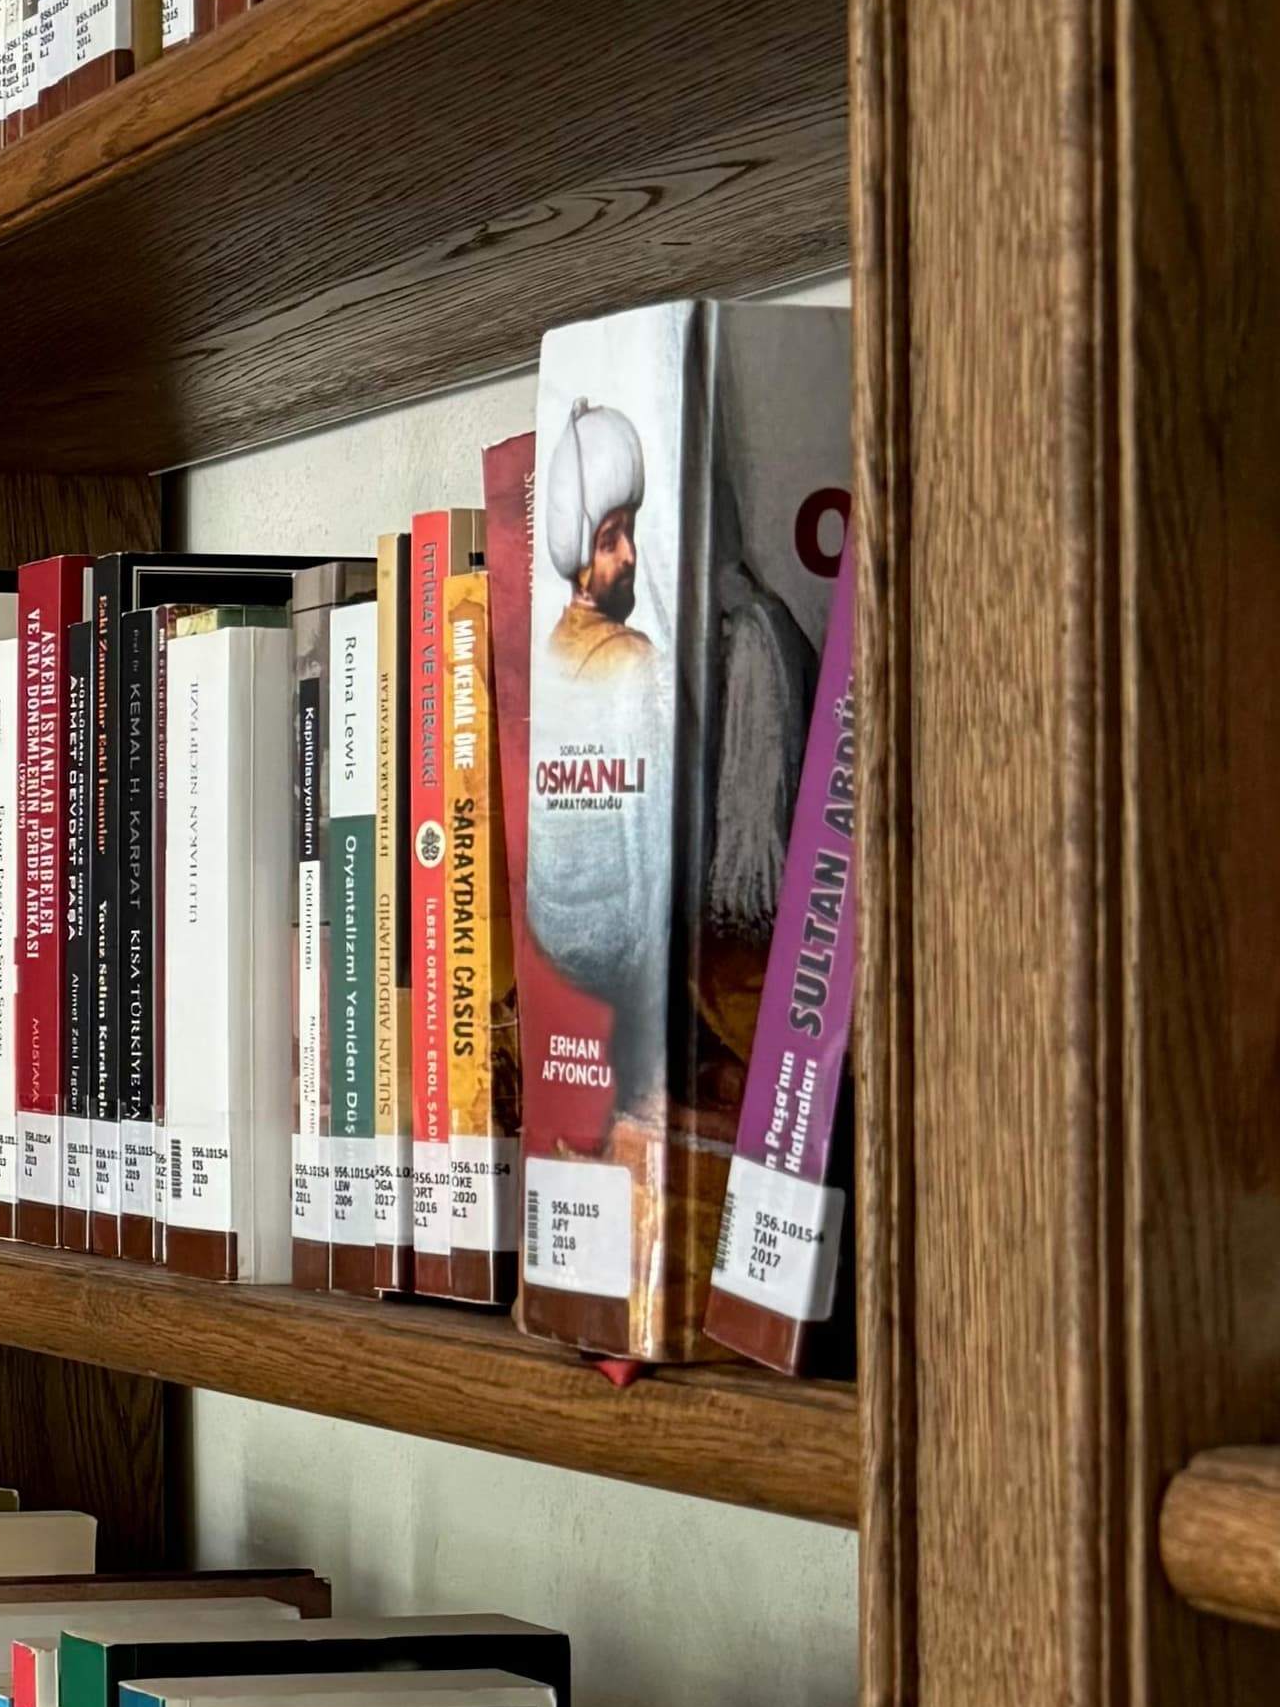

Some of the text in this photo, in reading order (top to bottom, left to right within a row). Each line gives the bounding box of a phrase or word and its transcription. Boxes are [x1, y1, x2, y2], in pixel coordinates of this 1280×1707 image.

[343, 635, 358, 782] Reina Lewis
[421, 541, 439, 790] İTTİHAT VE TERAKKİ
[452, 619, 474, 771] MİM KEMAL ÖKE
[26, 606, 42, 959] VE ARA DÖNEMLERİN PERDE ARKASI
[39, 629, 58, 936] ASKERİ İSYANLAR DARBELER
[129, 682, 141, 909] KEMAL H. KARPAT
[535, 757, 646, 796] OSMANLI
[129, 927, 142, 1088] KISA TÜRKİYE
[378, 892, 392, 1118] SULTAN ABDÜLHAMİD
[541, 1060, 612, 1088] AFYONCU
[549, 1034, 600, 1060] ERHAN
[765, 1050, 795, 1147] Paşa'nın
[551, 1233, 577, 1251] 2018
[750, 1246, 782, 1269] 2017
[753, 1228, 778, 1250] TAH
